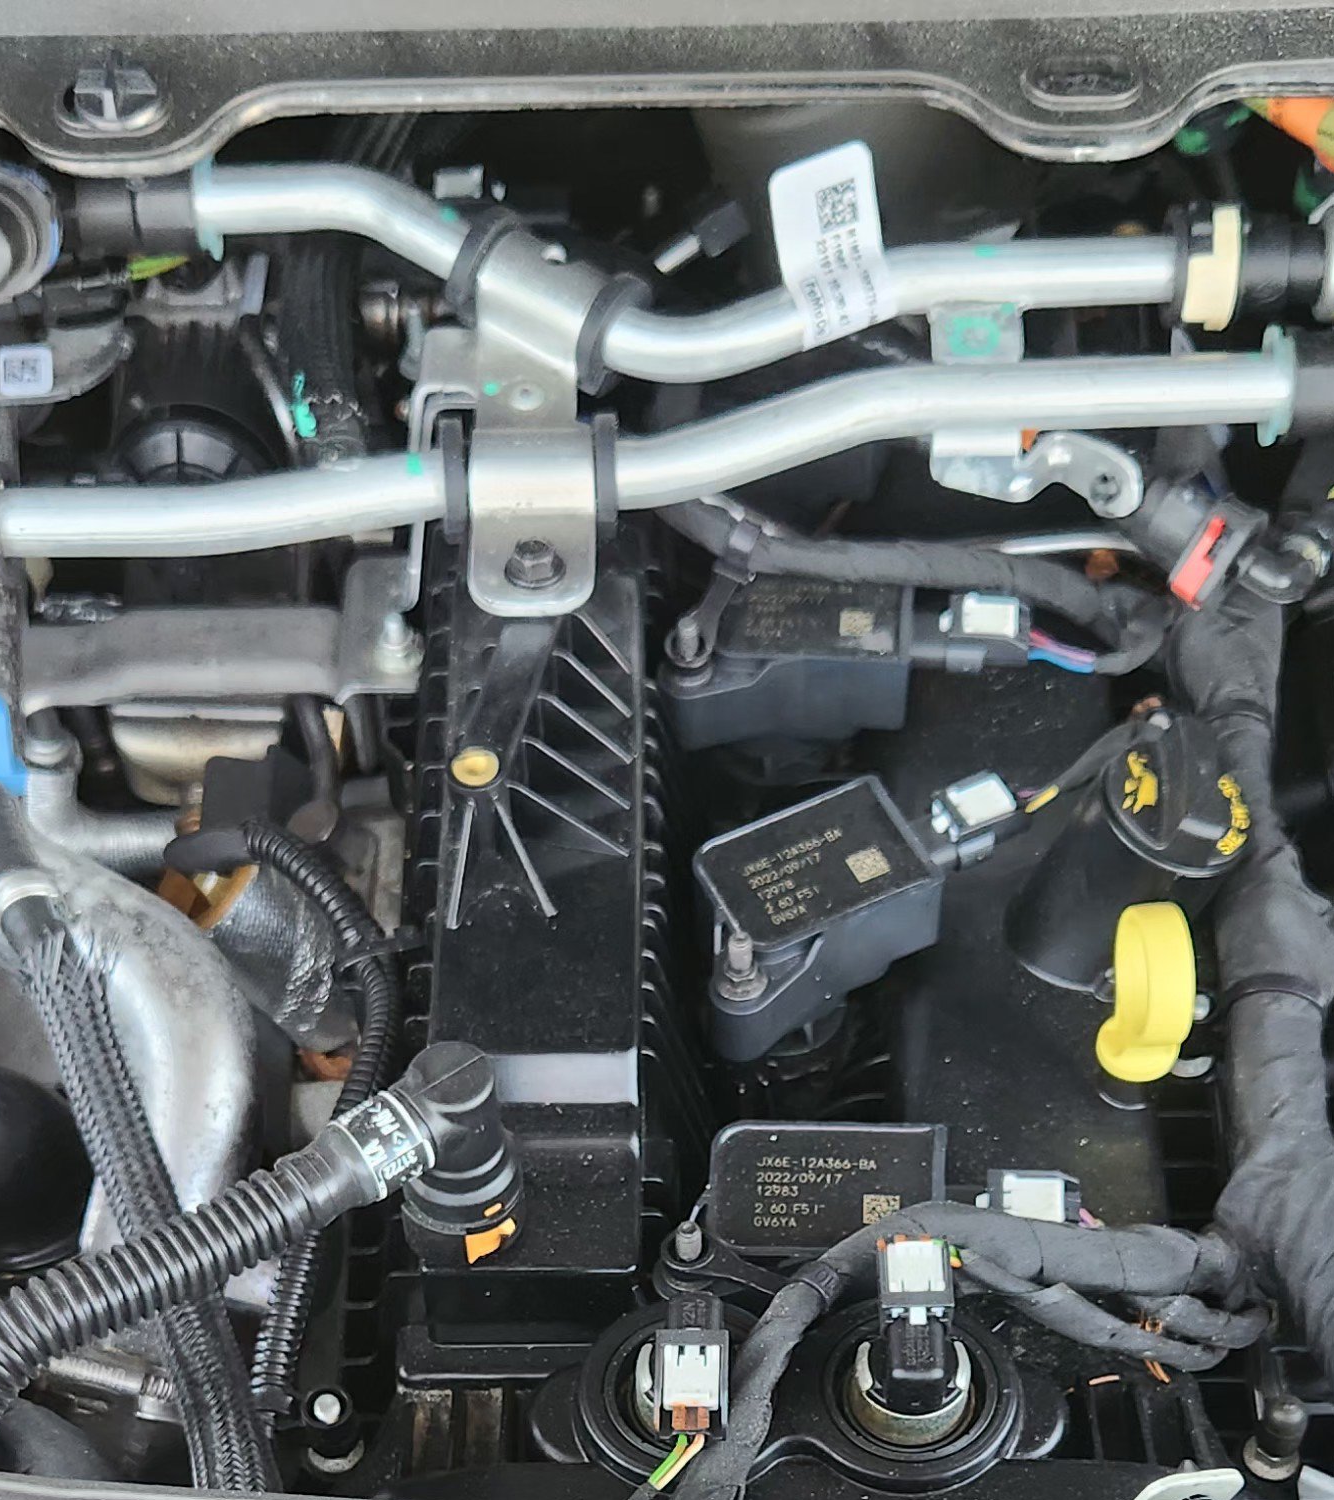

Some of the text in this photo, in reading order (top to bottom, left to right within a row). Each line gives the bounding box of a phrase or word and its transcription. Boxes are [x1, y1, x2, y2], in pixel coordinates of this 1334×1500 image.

[756, 1156, 878, 1171] JX6E-12A366-BA
[756, 1171, 843, 1185] 2022/09/17
[756, 1185, 799, 1197] 12983
[770, 1203, 787, 1215] 60
[753, 1217, 797, 1228] GV6YA
